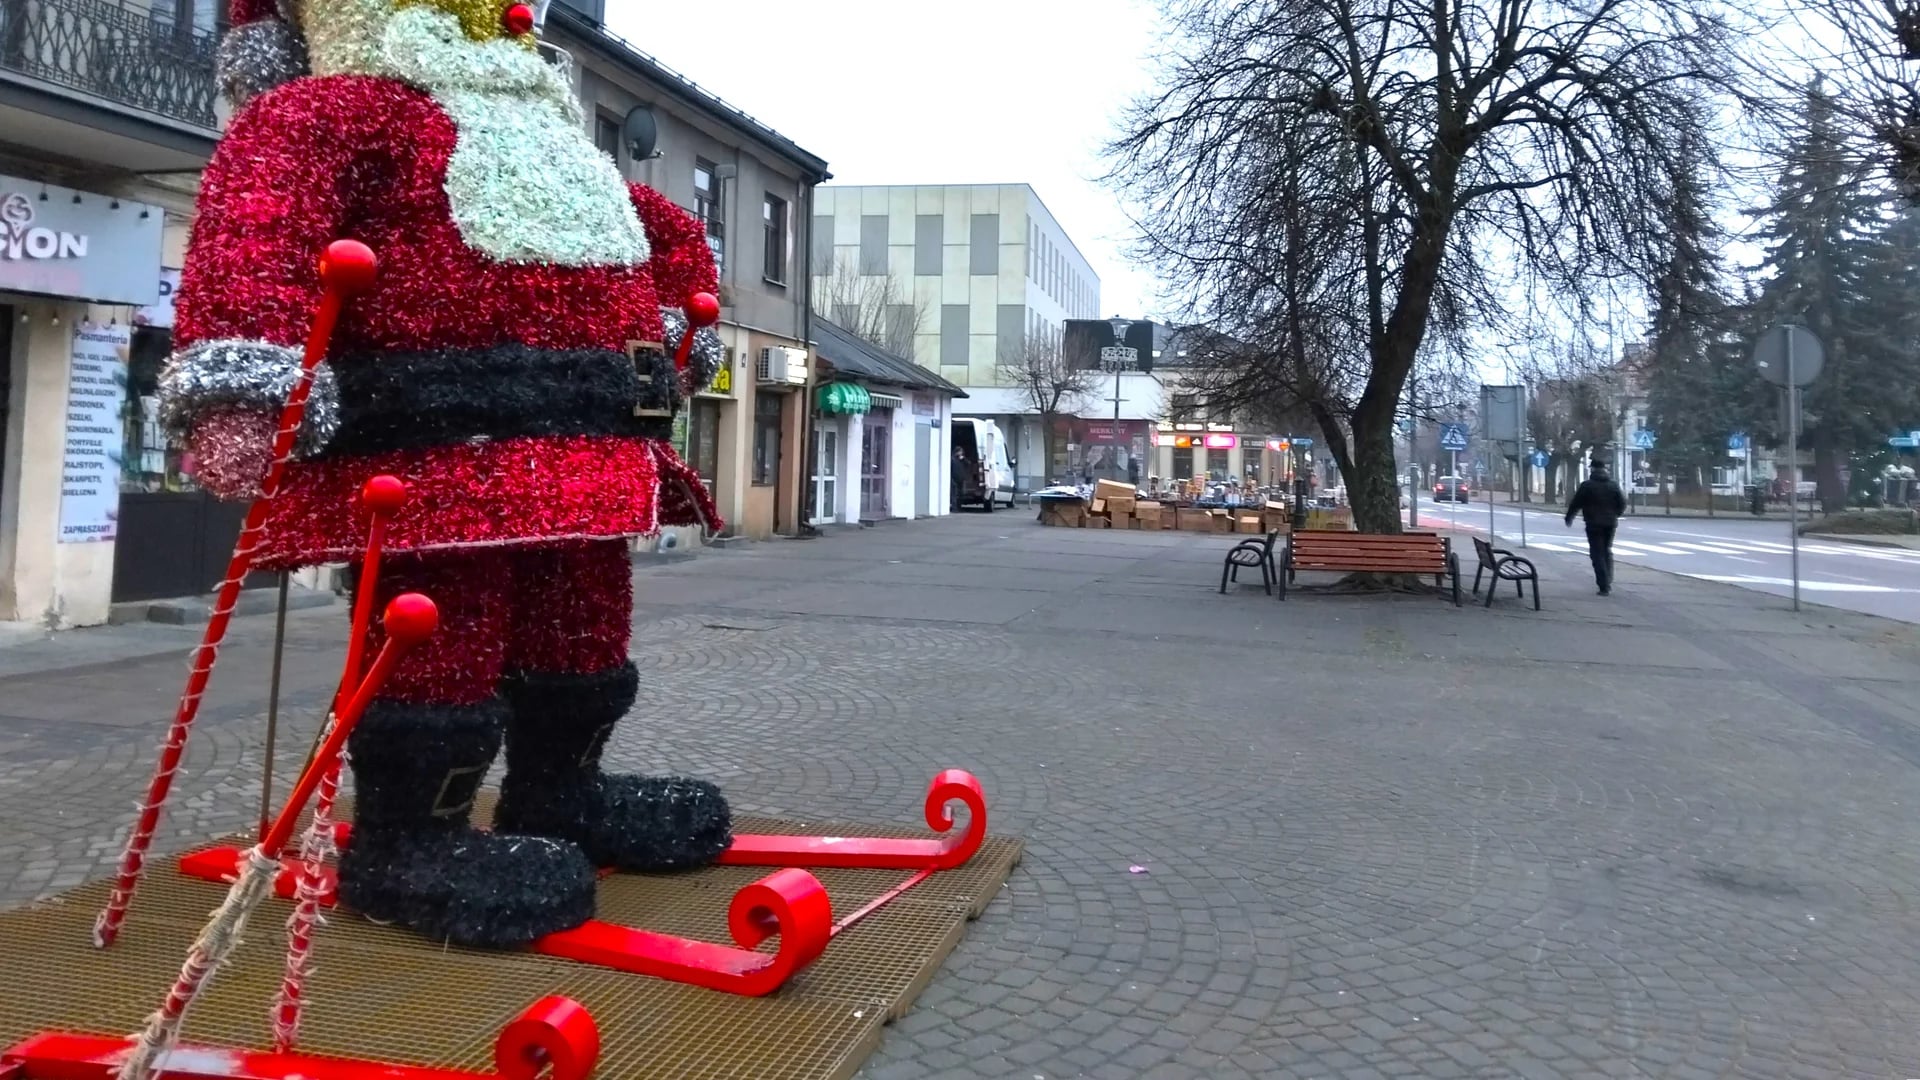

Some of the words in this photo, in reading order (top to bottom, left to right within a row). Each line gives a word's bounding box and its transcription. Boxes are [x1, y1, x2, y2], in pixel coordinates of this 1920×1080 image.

[75, 329, 128, 344] Pasmanteria
[67, 438, 103, 447] PORTFELE
[64, 461, 105, 470] RAJSTOPY,
[63, 524, 111, 534] ZAPRASZAMY
